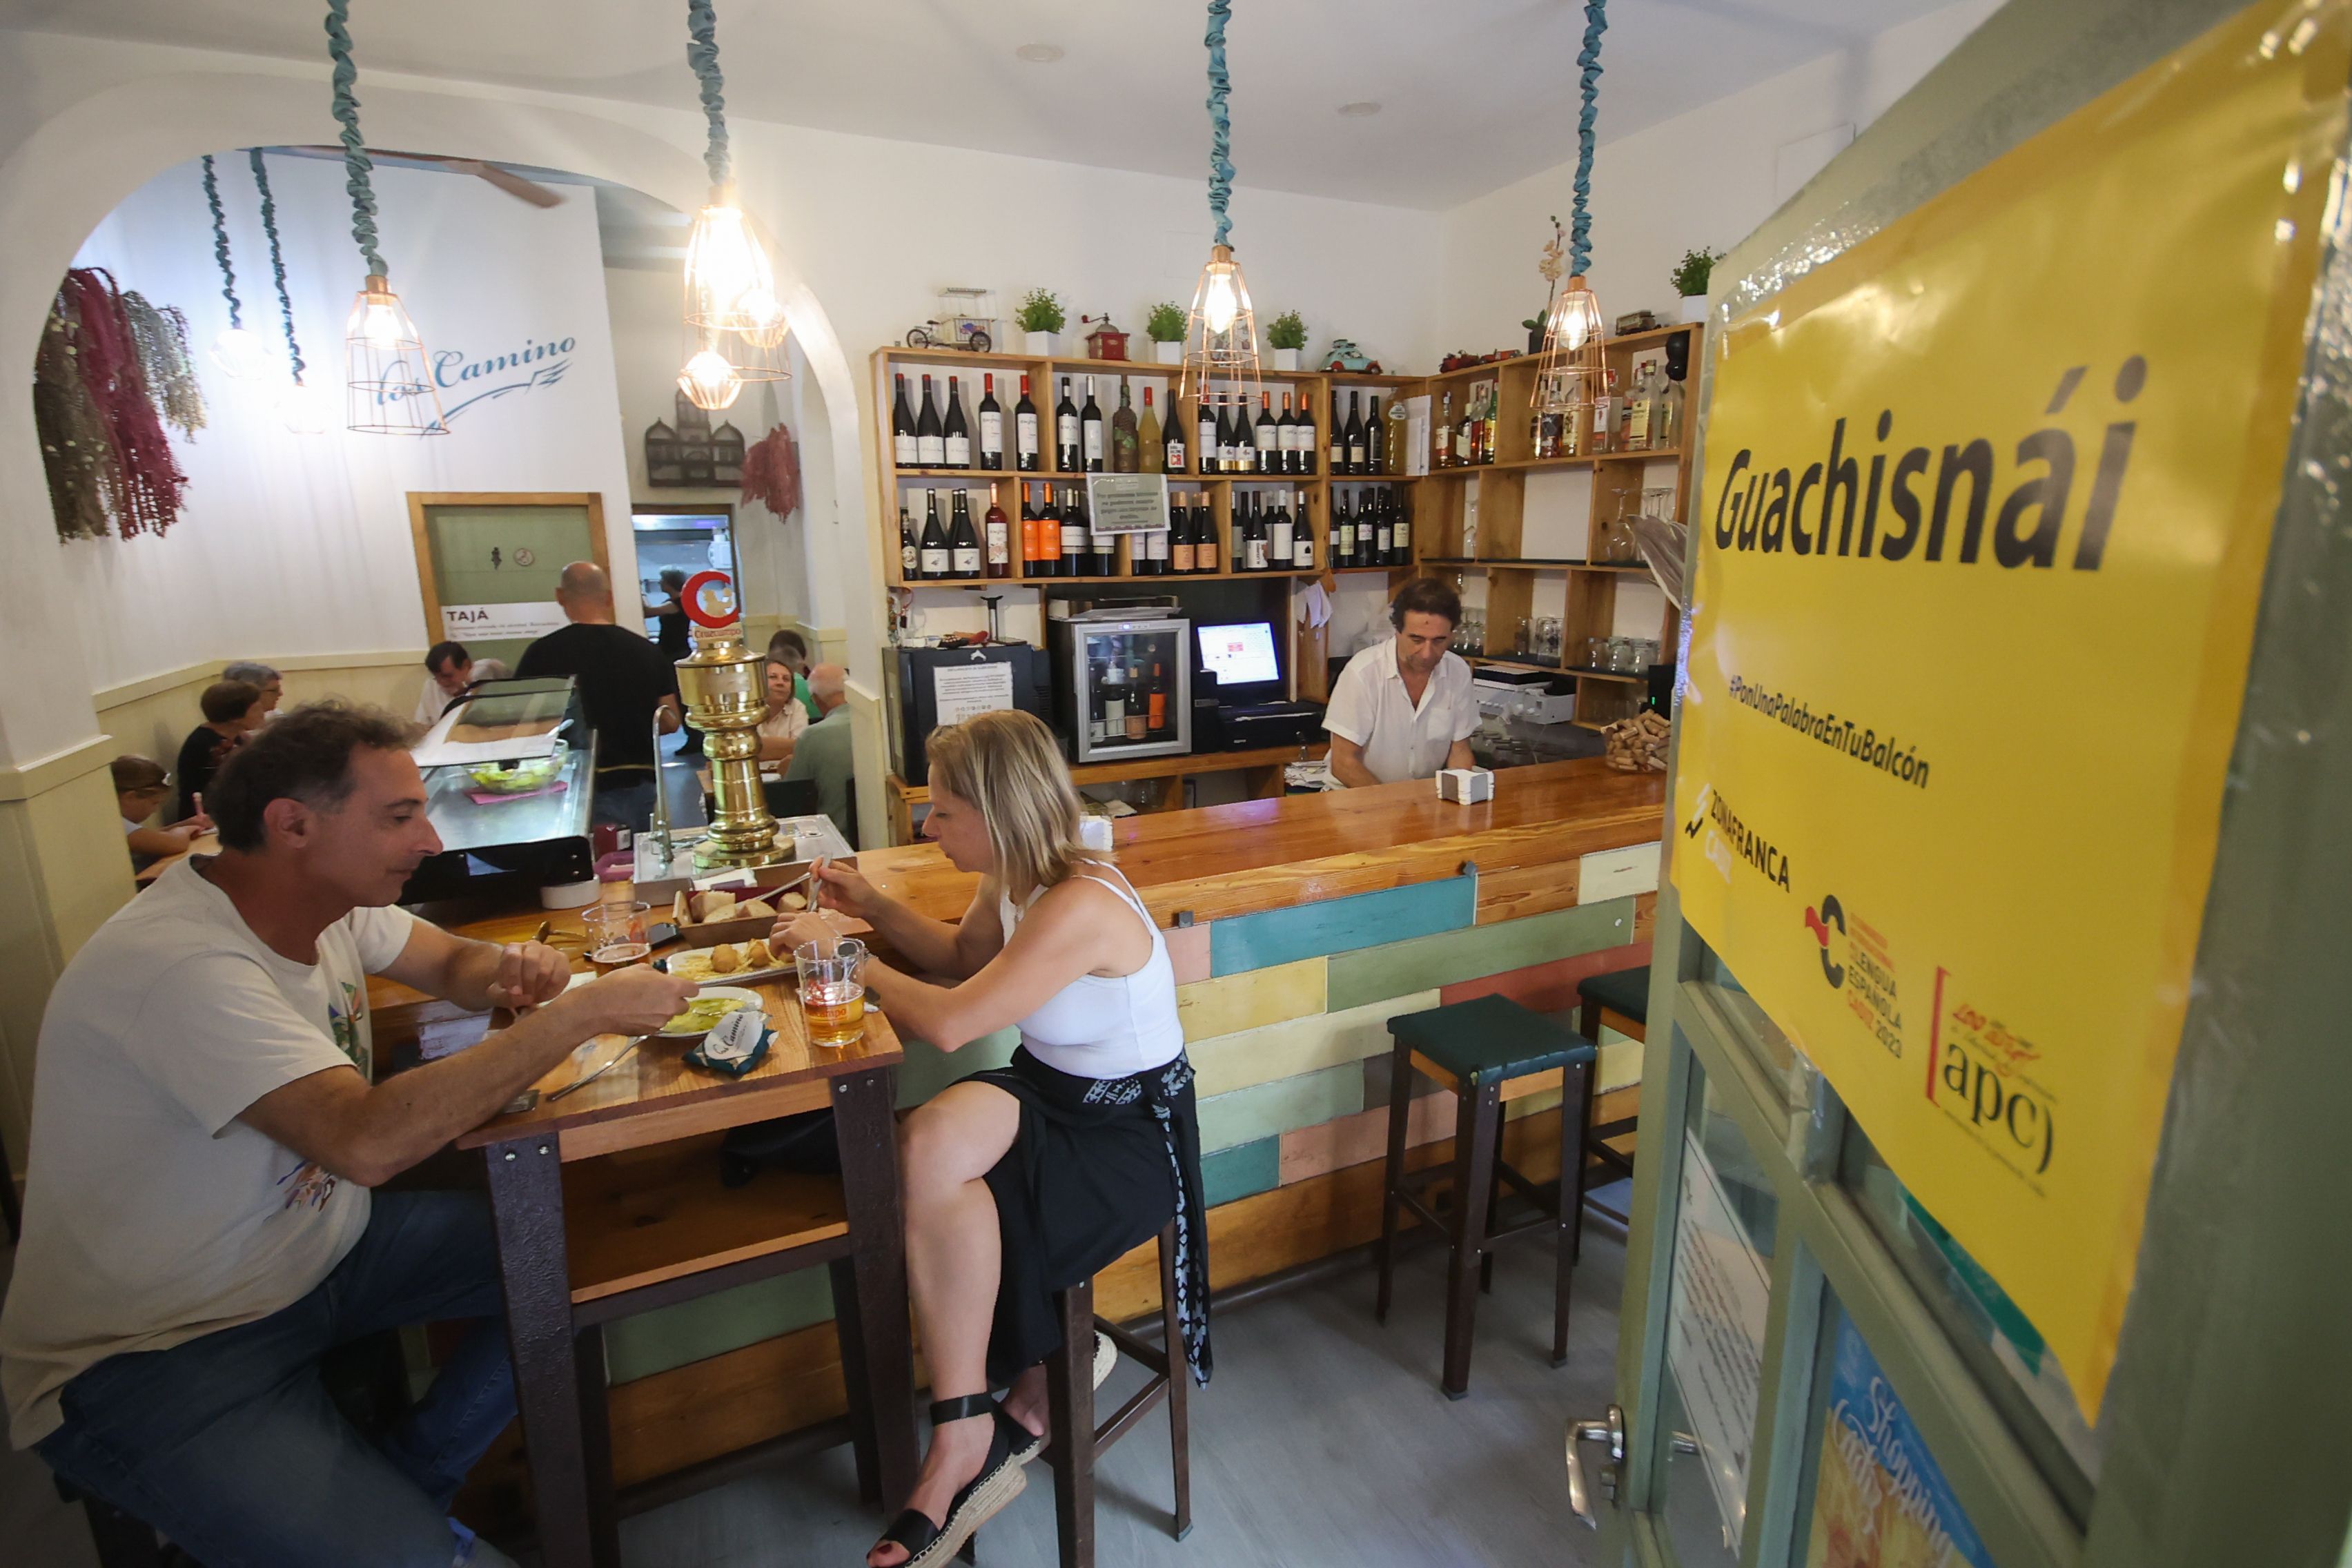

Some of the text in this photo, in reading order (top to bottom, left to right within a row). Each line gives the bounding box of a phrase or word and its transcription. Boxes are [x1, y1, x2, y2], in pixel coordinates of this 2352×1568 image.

[433, 337, 576, 388] Camino
[1714, 355, 2148, 572] Guachisnái
[1729, 674, 1930, 790] #PonUnaPalabraEnTuBalcón
